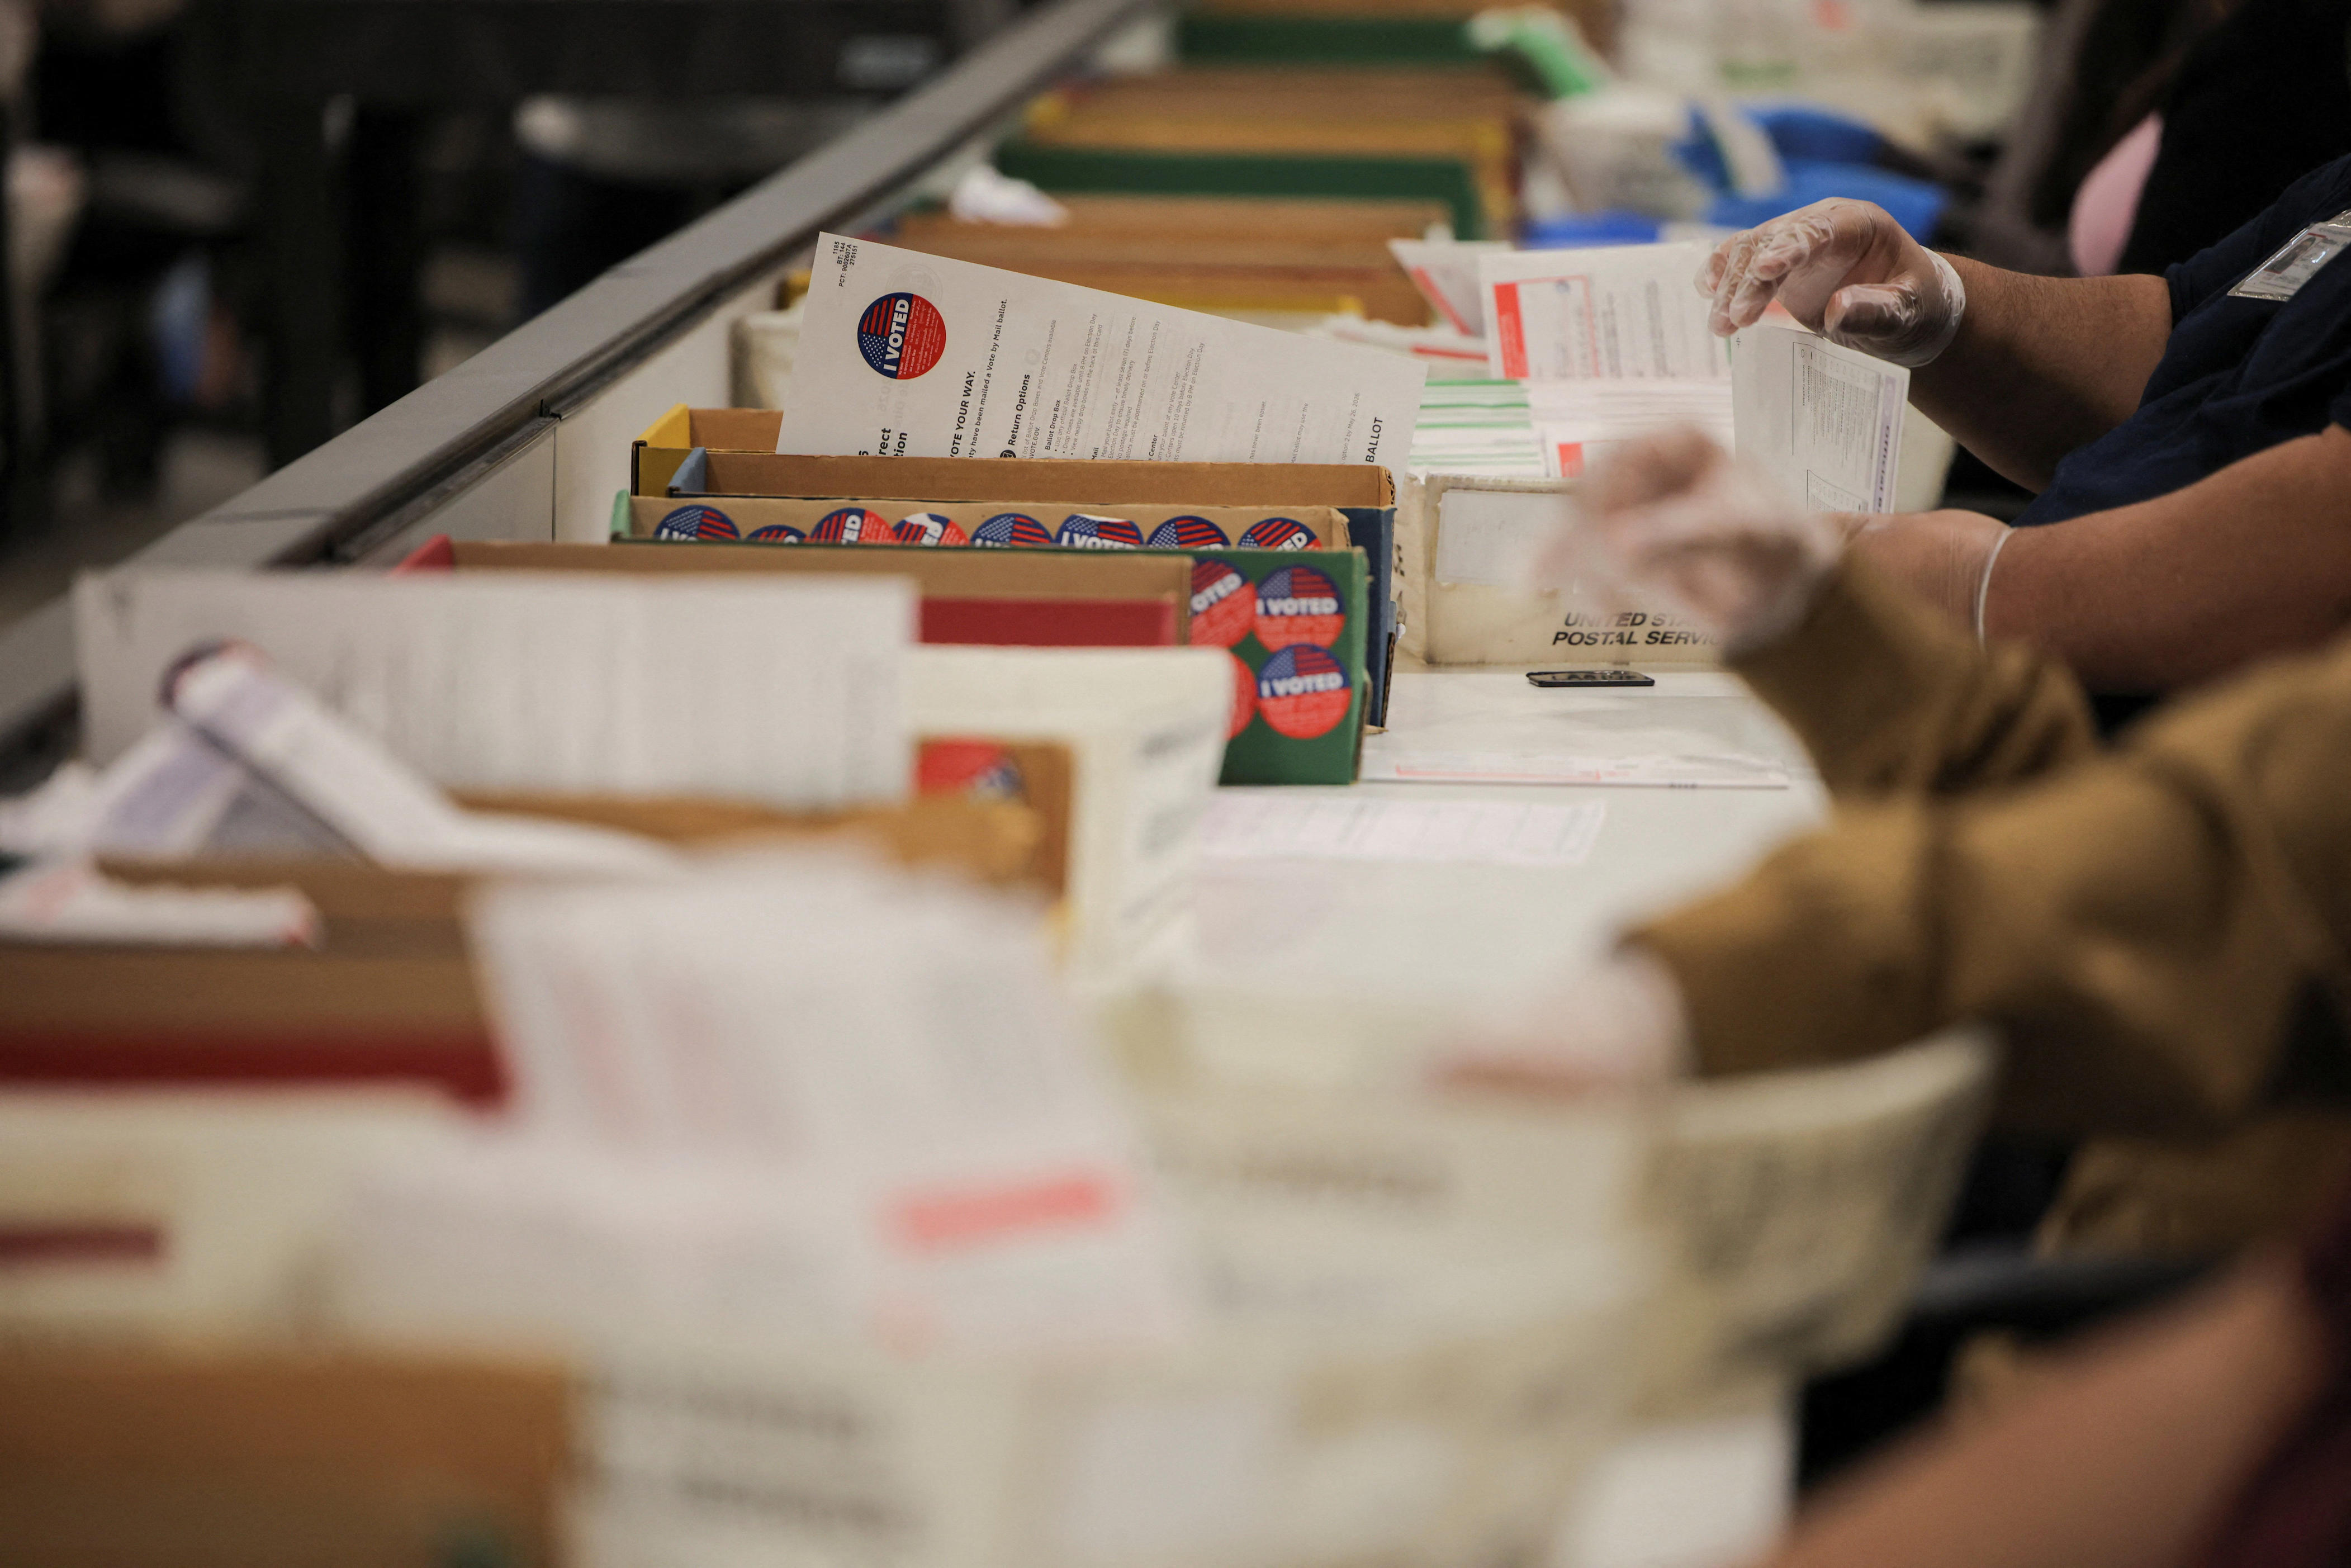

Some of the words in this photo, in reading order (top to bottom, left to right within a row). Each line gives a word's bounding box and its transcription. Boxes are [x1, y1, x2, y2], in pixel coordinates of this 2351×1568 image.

[842, 244, 852, 272] 9002607A
[849, 245, 858, 266] 275151
[996, 299, 1007, 323] ballot.
[1089, 314, 1098, 324] Day
[885, 299, 909, 360] VOTED
[993, 325, 1002, 340] Mail
[1048, 319, 1056, 343] available
[1153, 320, 1161, 331] Day
[1084, 325, 1094, 347] Election
[1148, 332, 1158, 354] Election
[990, 342, 999, 352] by
[1042, 344, 1051, 365] Centers
[883, 363, 897, 372] I
[986, 353, 996, 371] Vote
[1080, 356, 1087, 364] PM
[1144, 354, 1153, 372] before
[1106, 415, 1115, 432] ballot
[1128, 316, 1136, 334] before
[1126, 359, 1135, 381] delivery
[1182, 359, 1192, 381] Election
[1172, 371, 1181, 390] Center
[1181, 407, 1190, 430] returned
[1188, 385, 1195, 394] PM
[1192, 354, 1201, 376] Election
[1197, 342, 1205, 353] Day
[980, 379, 990, 405] mailed
[1032, 390, 1041, 407] Boxes
[1063, 389, 1072, 405] Ballot
[1072, 384, 1082, 408] available
[1121, 382, 1130, 399] timely
[1178, 382, 1187, 400] before
[955, 400, 969, 430] YOUR
[963, 371, 975, 397] WAY.
[1008, 414, 1022, 446] Return
[1016, 374, 1030, 411] Options
[1117, 399, 1126, 418] ensure
[1134, 388, 1145, 420] postmarked
[974, 407, 984, 426] been
[1030, 408, 1038, 421] Drop
[1060, 406, 1068, 424] official
[1026, 421, 1034, 438] Ballot
[1045, 430, 1054, 450] Ballot
[1050, 413, 1059, 429] Drop
[1065, 418, 1074, 434] boxes
[1074, 418, 1083, 437] nearby
[1112, 425, 1121, 437] Day
[1119, 430, 1128, 452] postage
[1124, 406, 1132, 429] required
[879, 428, 892, 456] rect
[970, 428, 979, 446] have
[1062, 435, 1071, 449] Drop
[1149, 434, 1158, 457] Center
[1293, 437, 1301, 452] ballot
[1365, 416, 1383, 463] BALLOT
[1107, 437, 1117, 459] Election
[1124, 444, 1132, 462] allots
[1165, 437, 1175, 458] Centers
[1060, 531, 1070, 547] I
[1255, 598, 1265, 615] I
[1266, 596, 1339, 615] VOTED
[1551, 631, 1638, 646] POSTAL
[1260, 679, 1272, 698] I
[1272, 672, 1344, 697] VOTED
